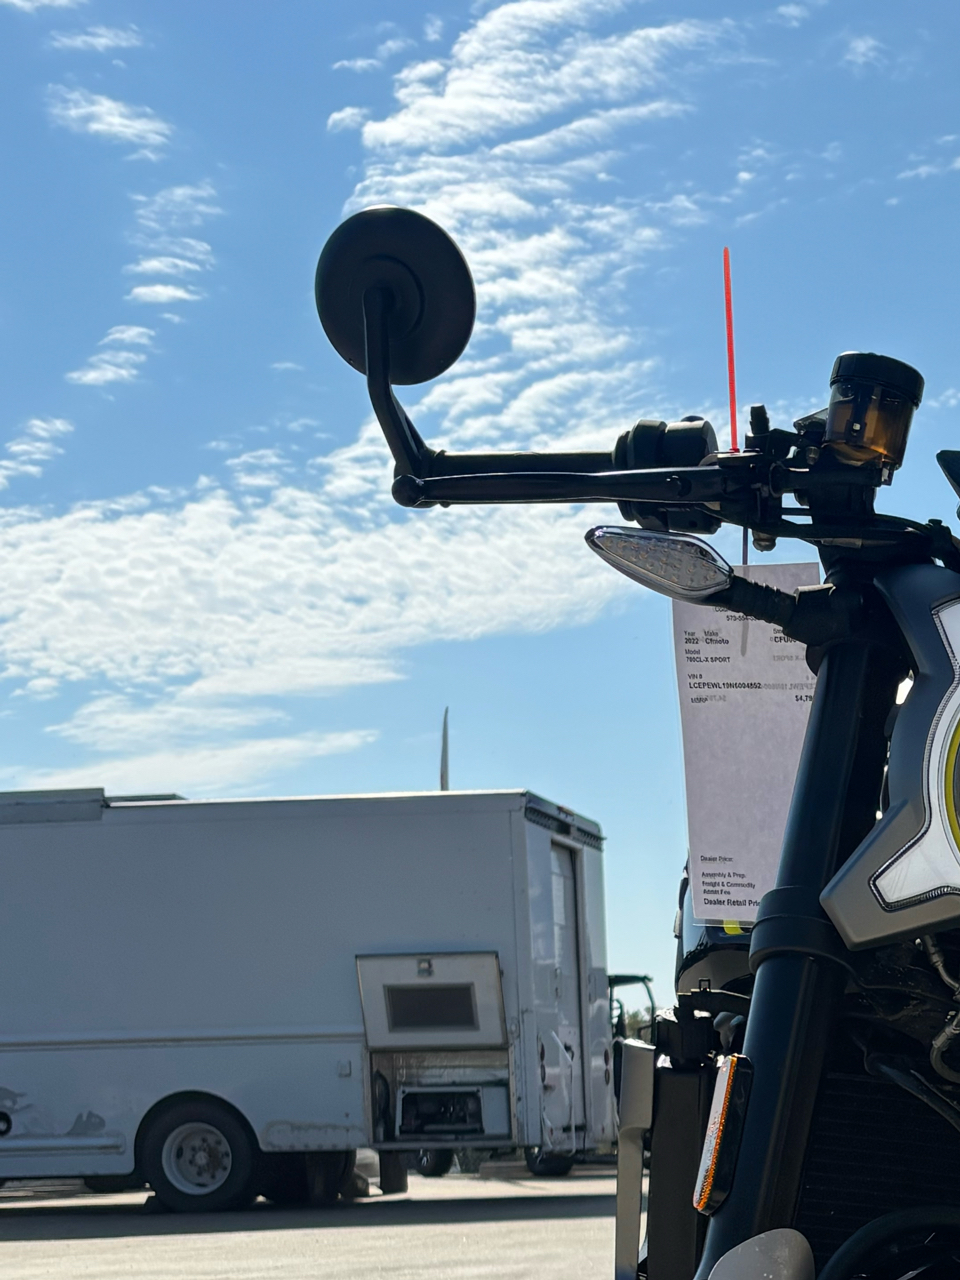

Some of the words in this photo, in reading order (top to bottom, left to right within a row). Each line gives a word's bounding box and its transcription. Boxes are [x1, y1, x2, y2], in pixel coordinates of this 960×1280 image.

[684, 637, 699, 645] 2022
[705, 637, 730, 645] Cfmoto
[727, 882, 756, 890] Commodity
[727, 899, 747, 907] Retail
